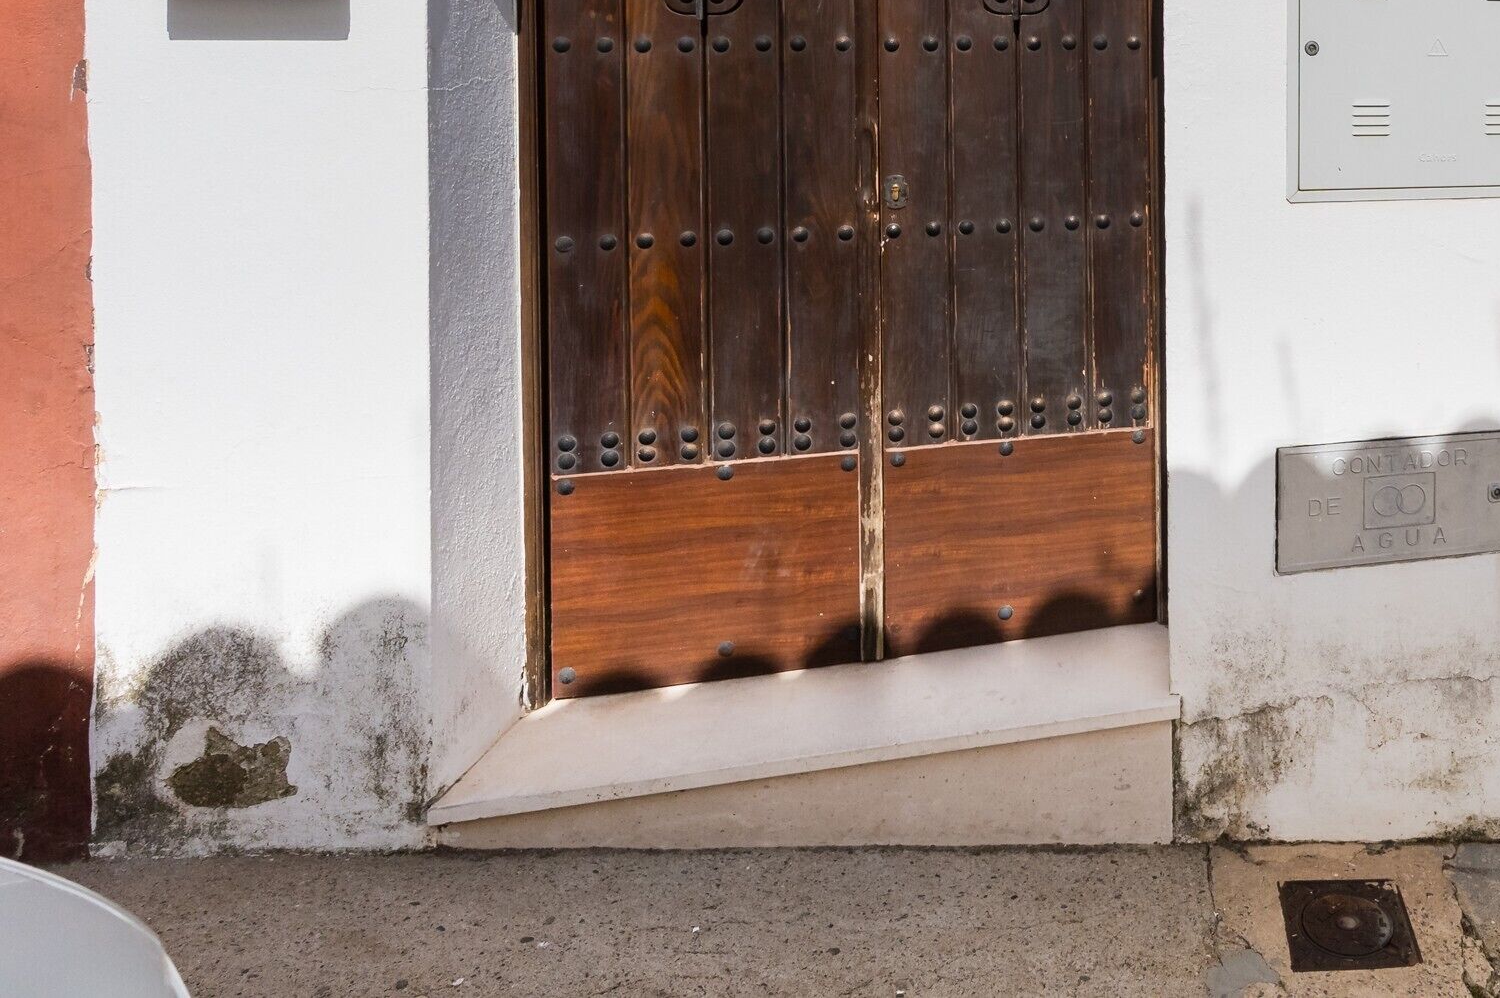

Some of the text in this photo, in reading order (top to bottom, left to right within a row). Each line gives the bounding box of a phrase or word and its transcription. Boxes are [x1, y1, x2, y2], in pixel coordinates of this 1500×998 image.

[1332, 449, 1468, 476] CONTADOR
[1308, 498, 1341, 517] DE
[1352, 527, 1447, 553] AGUA
